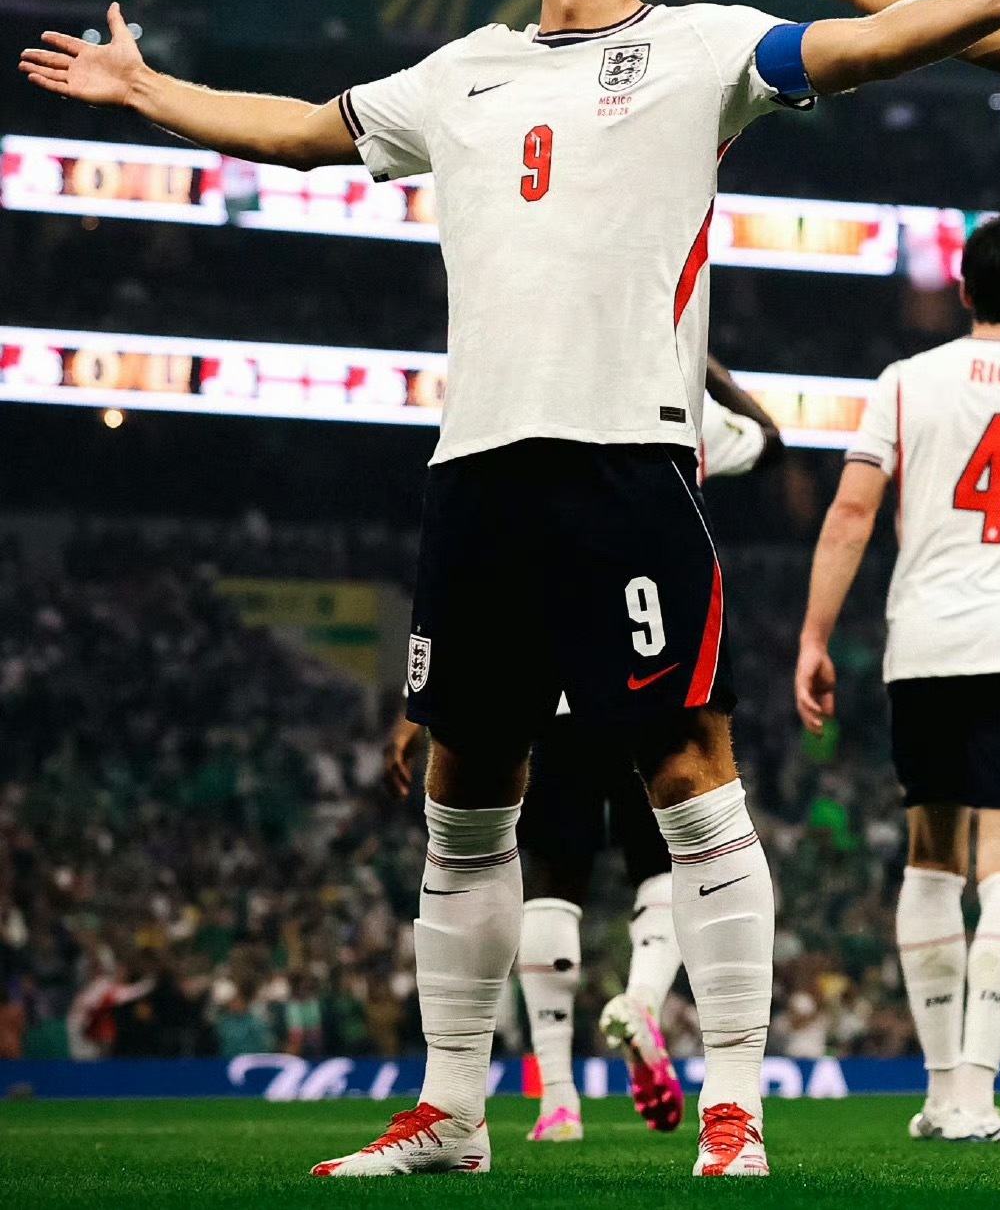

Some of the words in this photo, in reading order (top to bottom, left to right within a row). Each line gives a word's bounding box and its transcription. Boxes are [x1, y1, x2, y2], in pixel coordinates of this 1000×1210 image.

[599, 96, 632, 105] MEXICO
[520, 125, 554, 202] 9
[624, 576, 666, 657] 9
